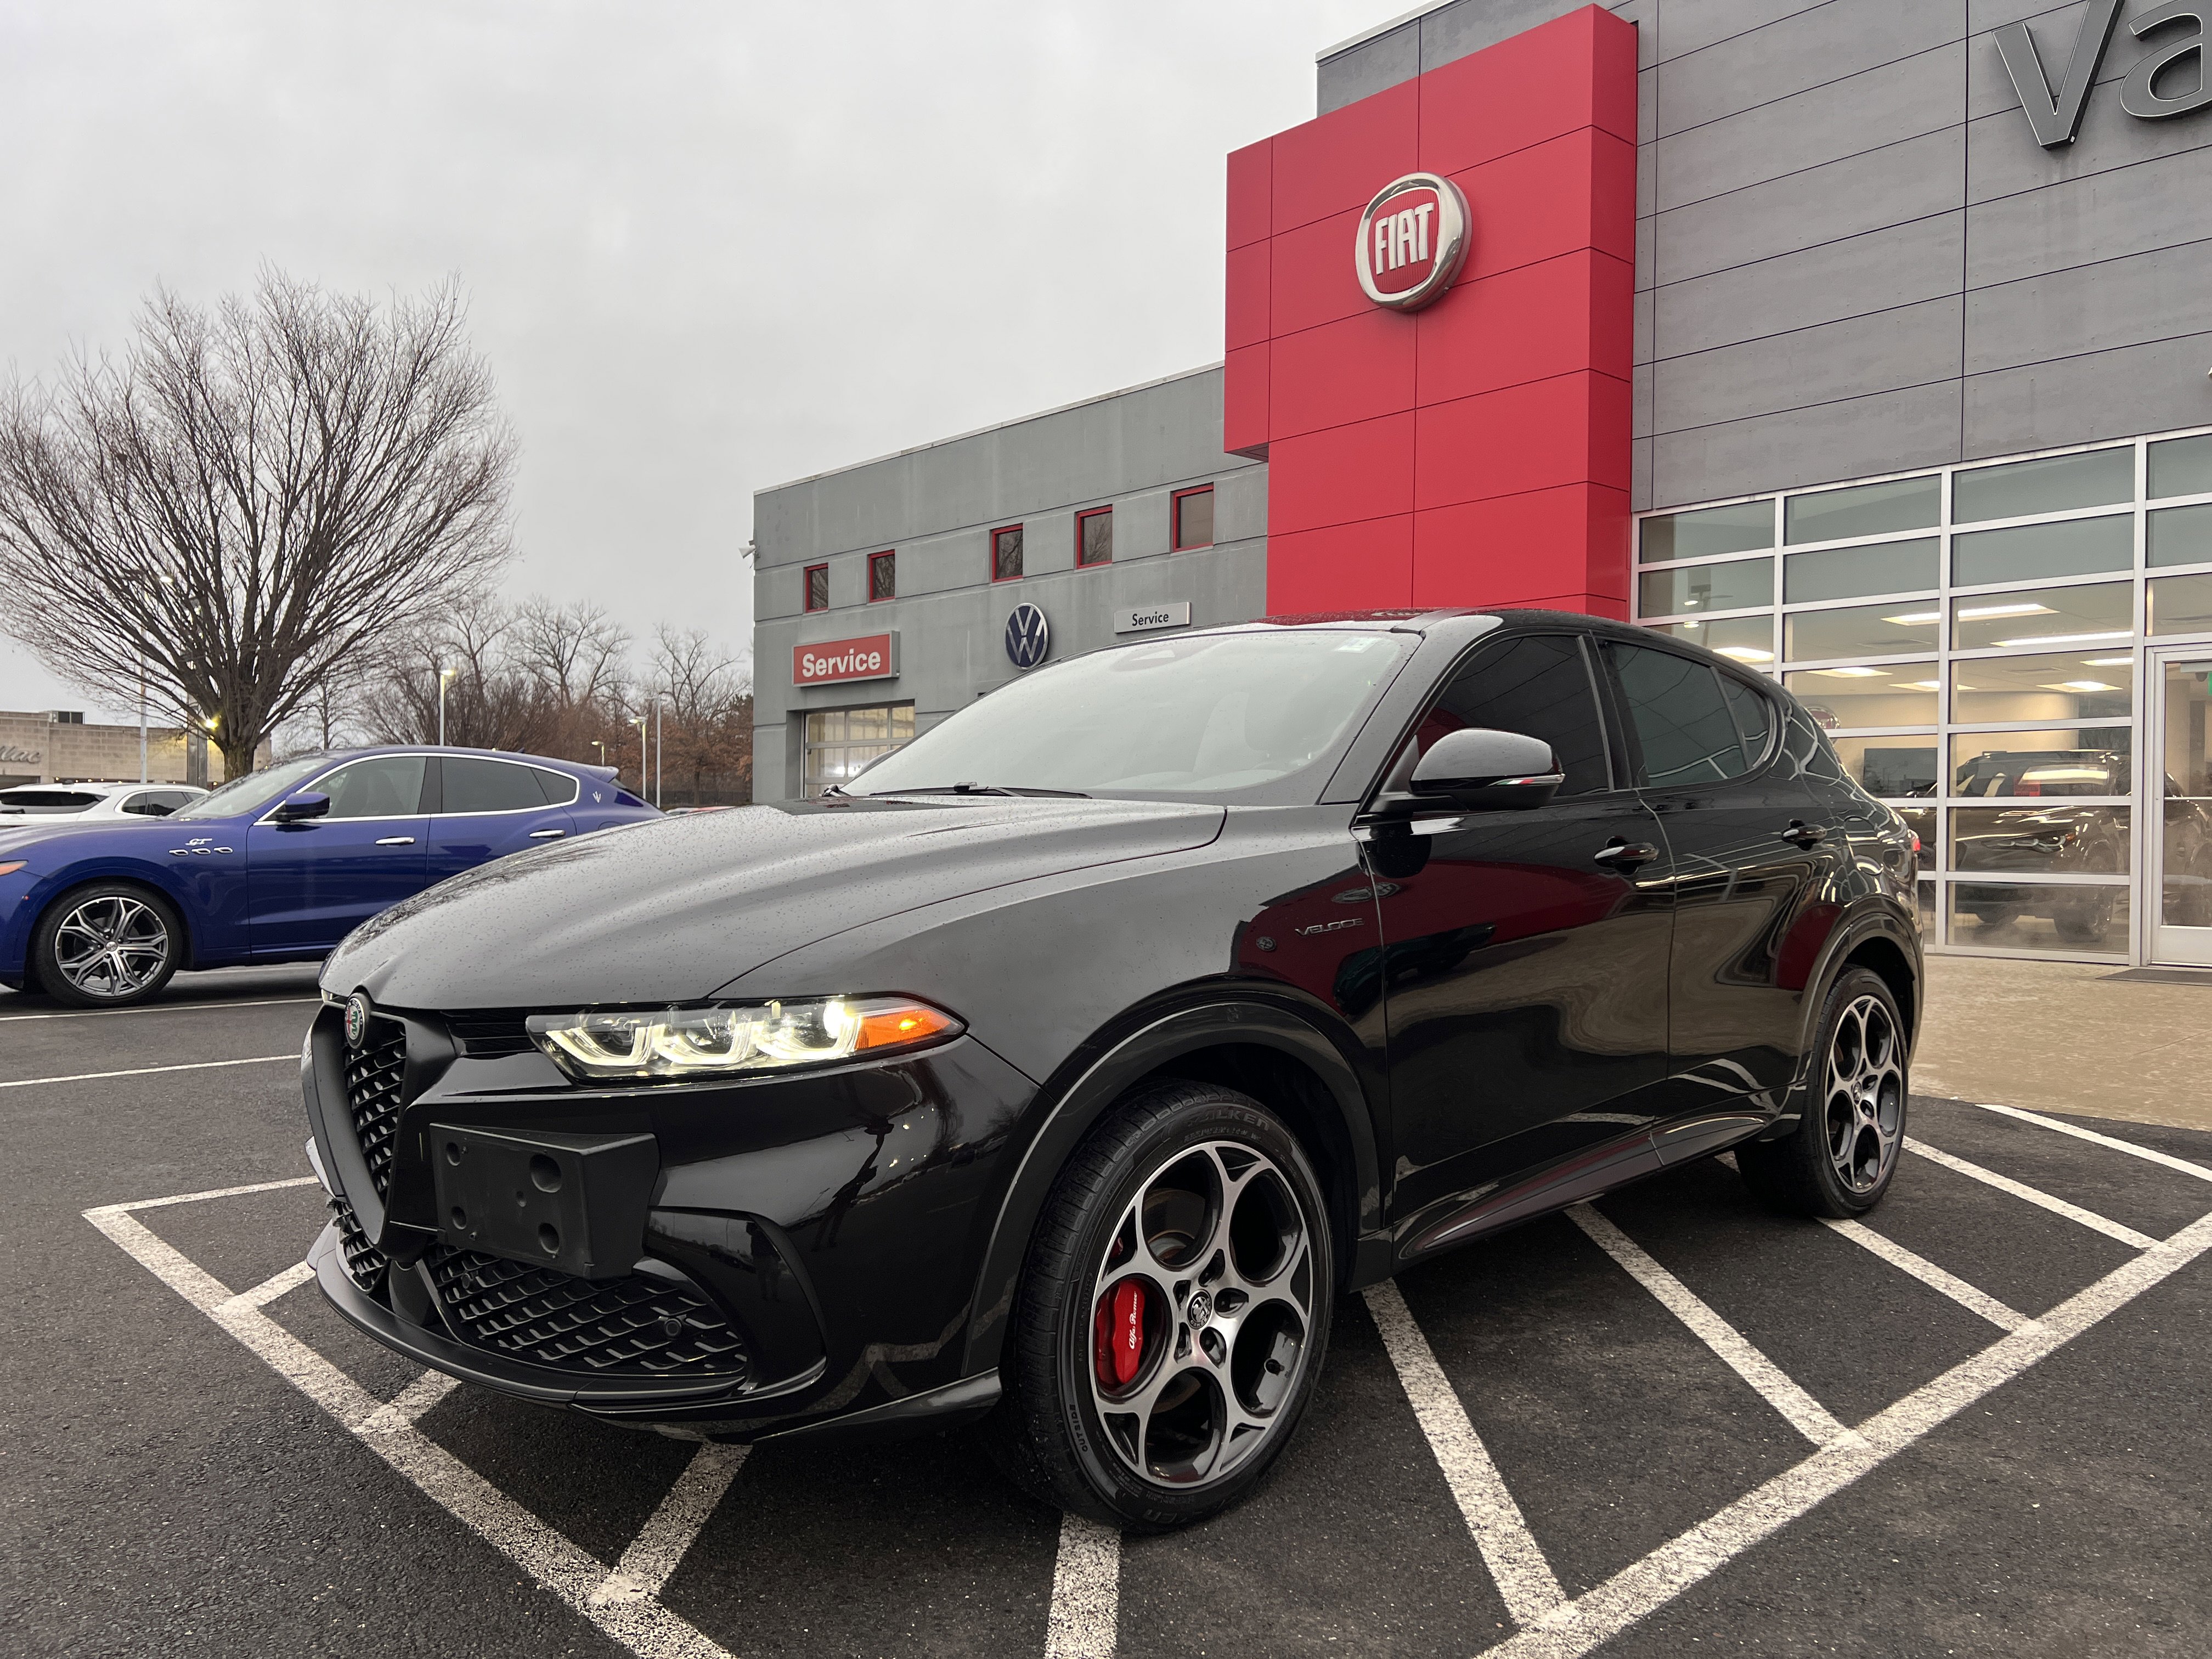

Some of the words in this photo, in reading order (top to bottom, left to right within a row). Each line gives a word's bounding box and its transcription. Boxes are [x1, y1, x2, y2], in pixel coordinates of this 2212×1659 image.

[1991, 0, 2212, 148] Va
[1375, 202, 1434, 275] FIAT
[1131, 611, 1169, 627] Service
[802, 648, 881, 678] Service
[1294, 918, 1365, 936] VELOCE
[1129, 1290, 1137, 1325] Romeo
[1128, 1325, 1137, 1350] Alfa
[1069, 1403, 1088, 1452] OUTSIDE
